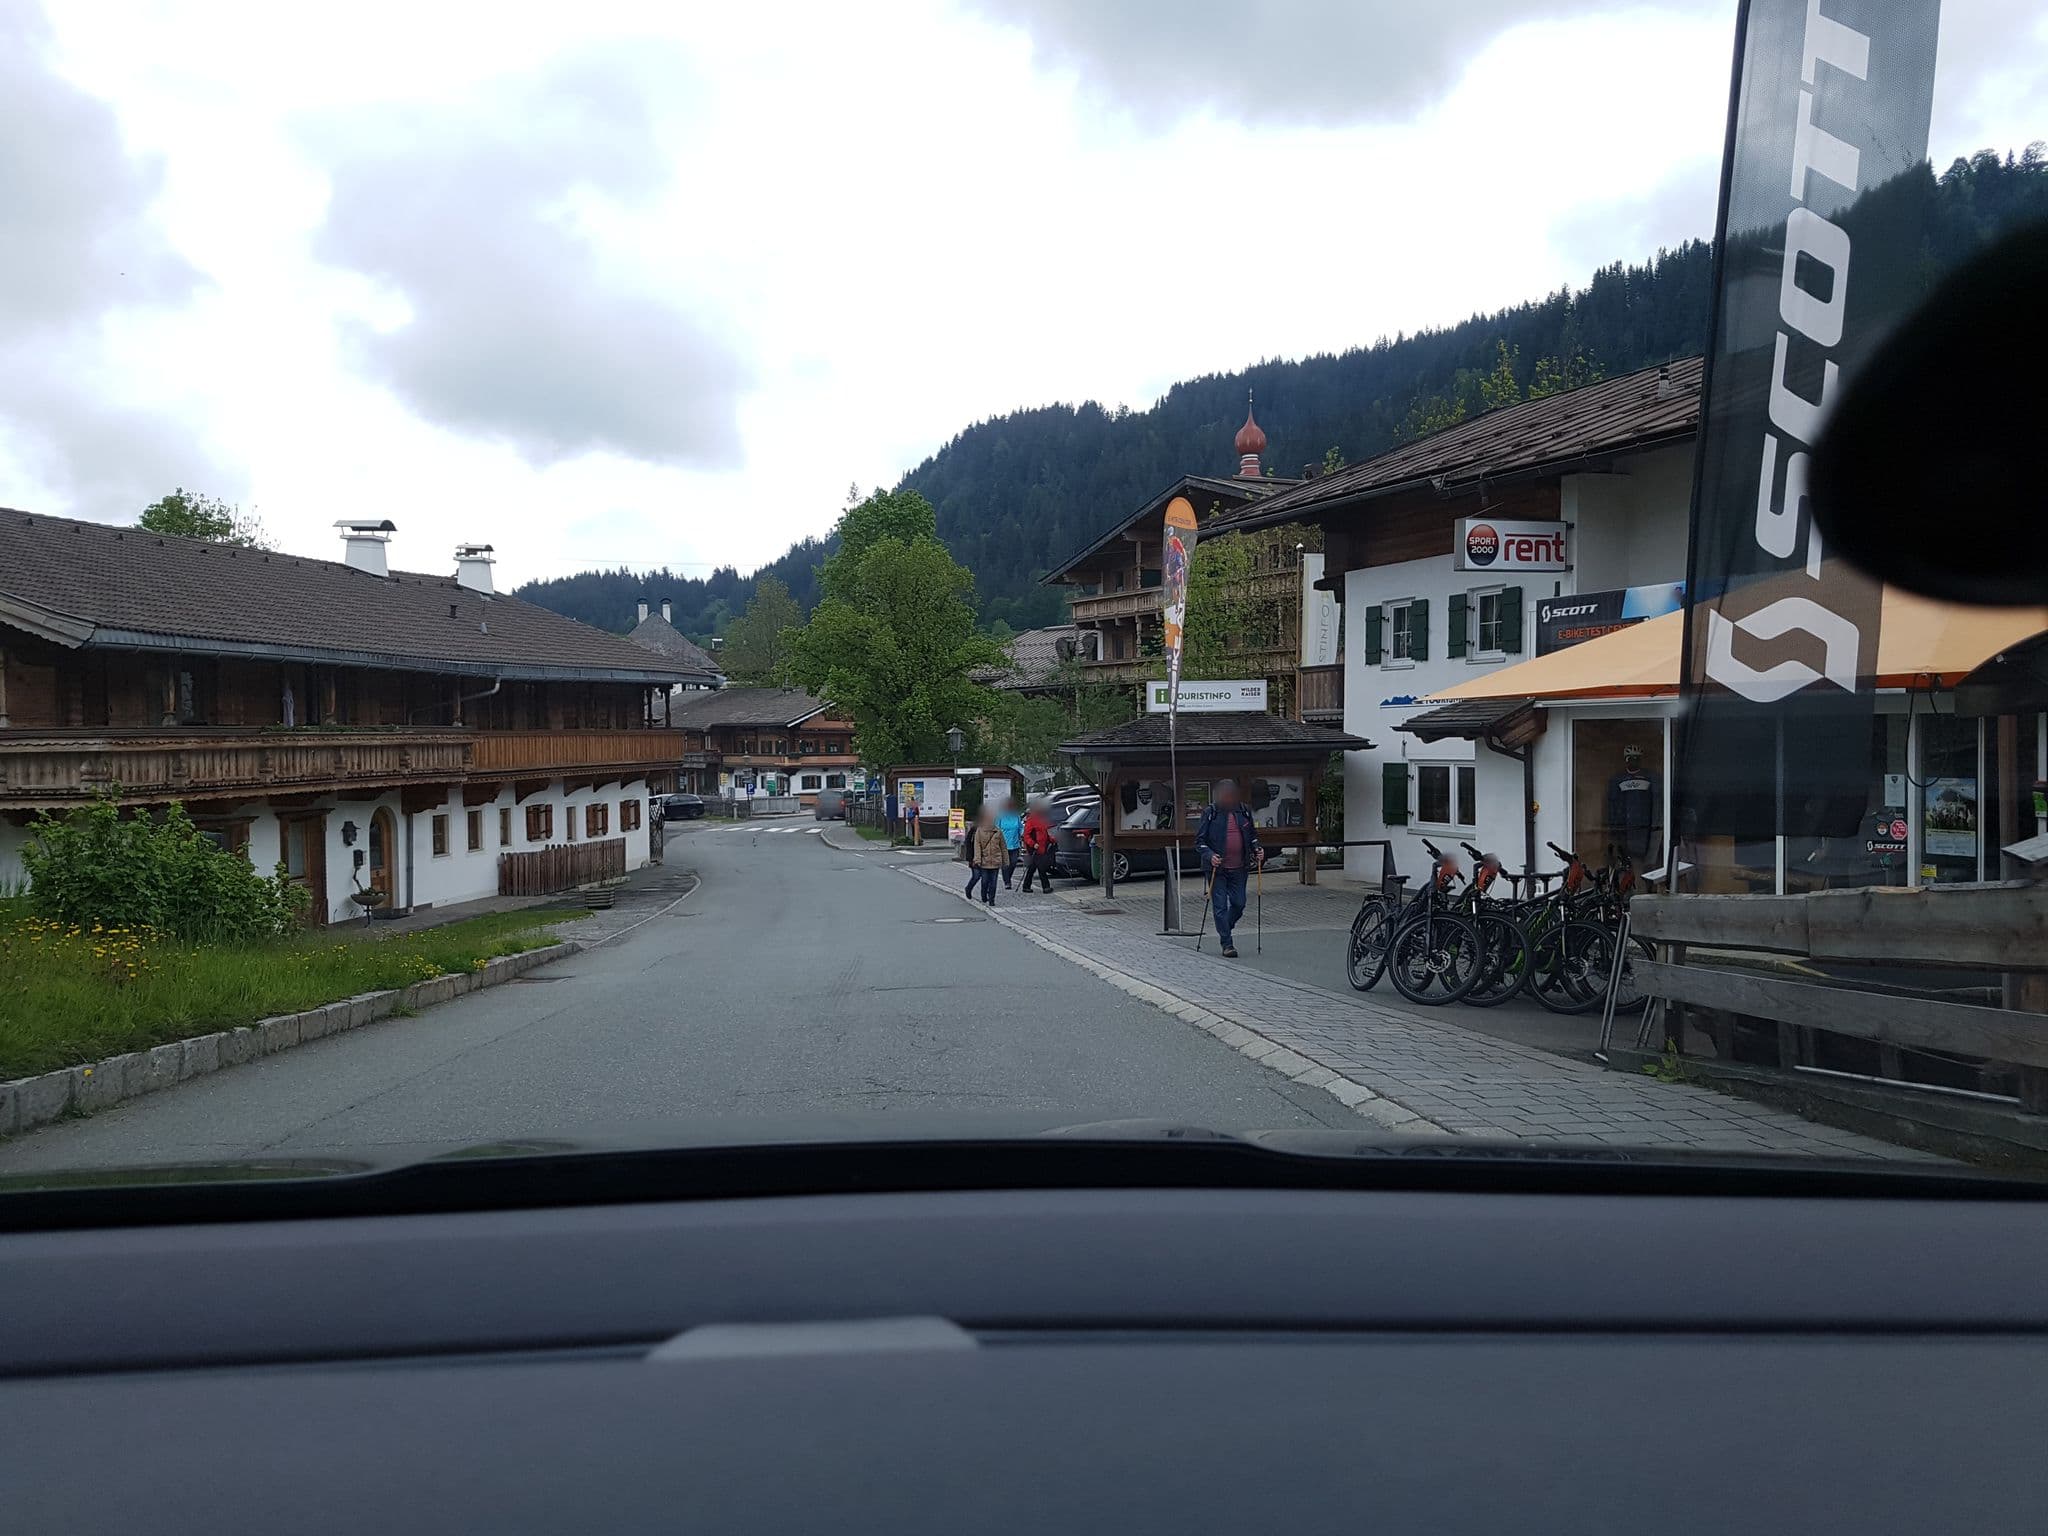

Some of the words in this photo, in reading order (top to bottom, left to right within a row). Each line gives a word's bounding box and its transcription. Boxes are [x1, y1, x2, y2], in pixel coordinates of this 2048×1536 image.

[1756, 0, 1870, 580] SCOTT
[1469, 536, 1497, 545] SPORT
[1471, 546, 1494, 554] 2000
[1504, 531, 1565, 562] rent
[1551, 604, 1598, 618] SCOTT
[1558, 627, 1585, 640] E-BIKE
[1586, 625, 1606, 637] TEST
[1176, 692, 1232, 700] OURISTINFO
[1874, 842, 1906, 850] SCOTT
